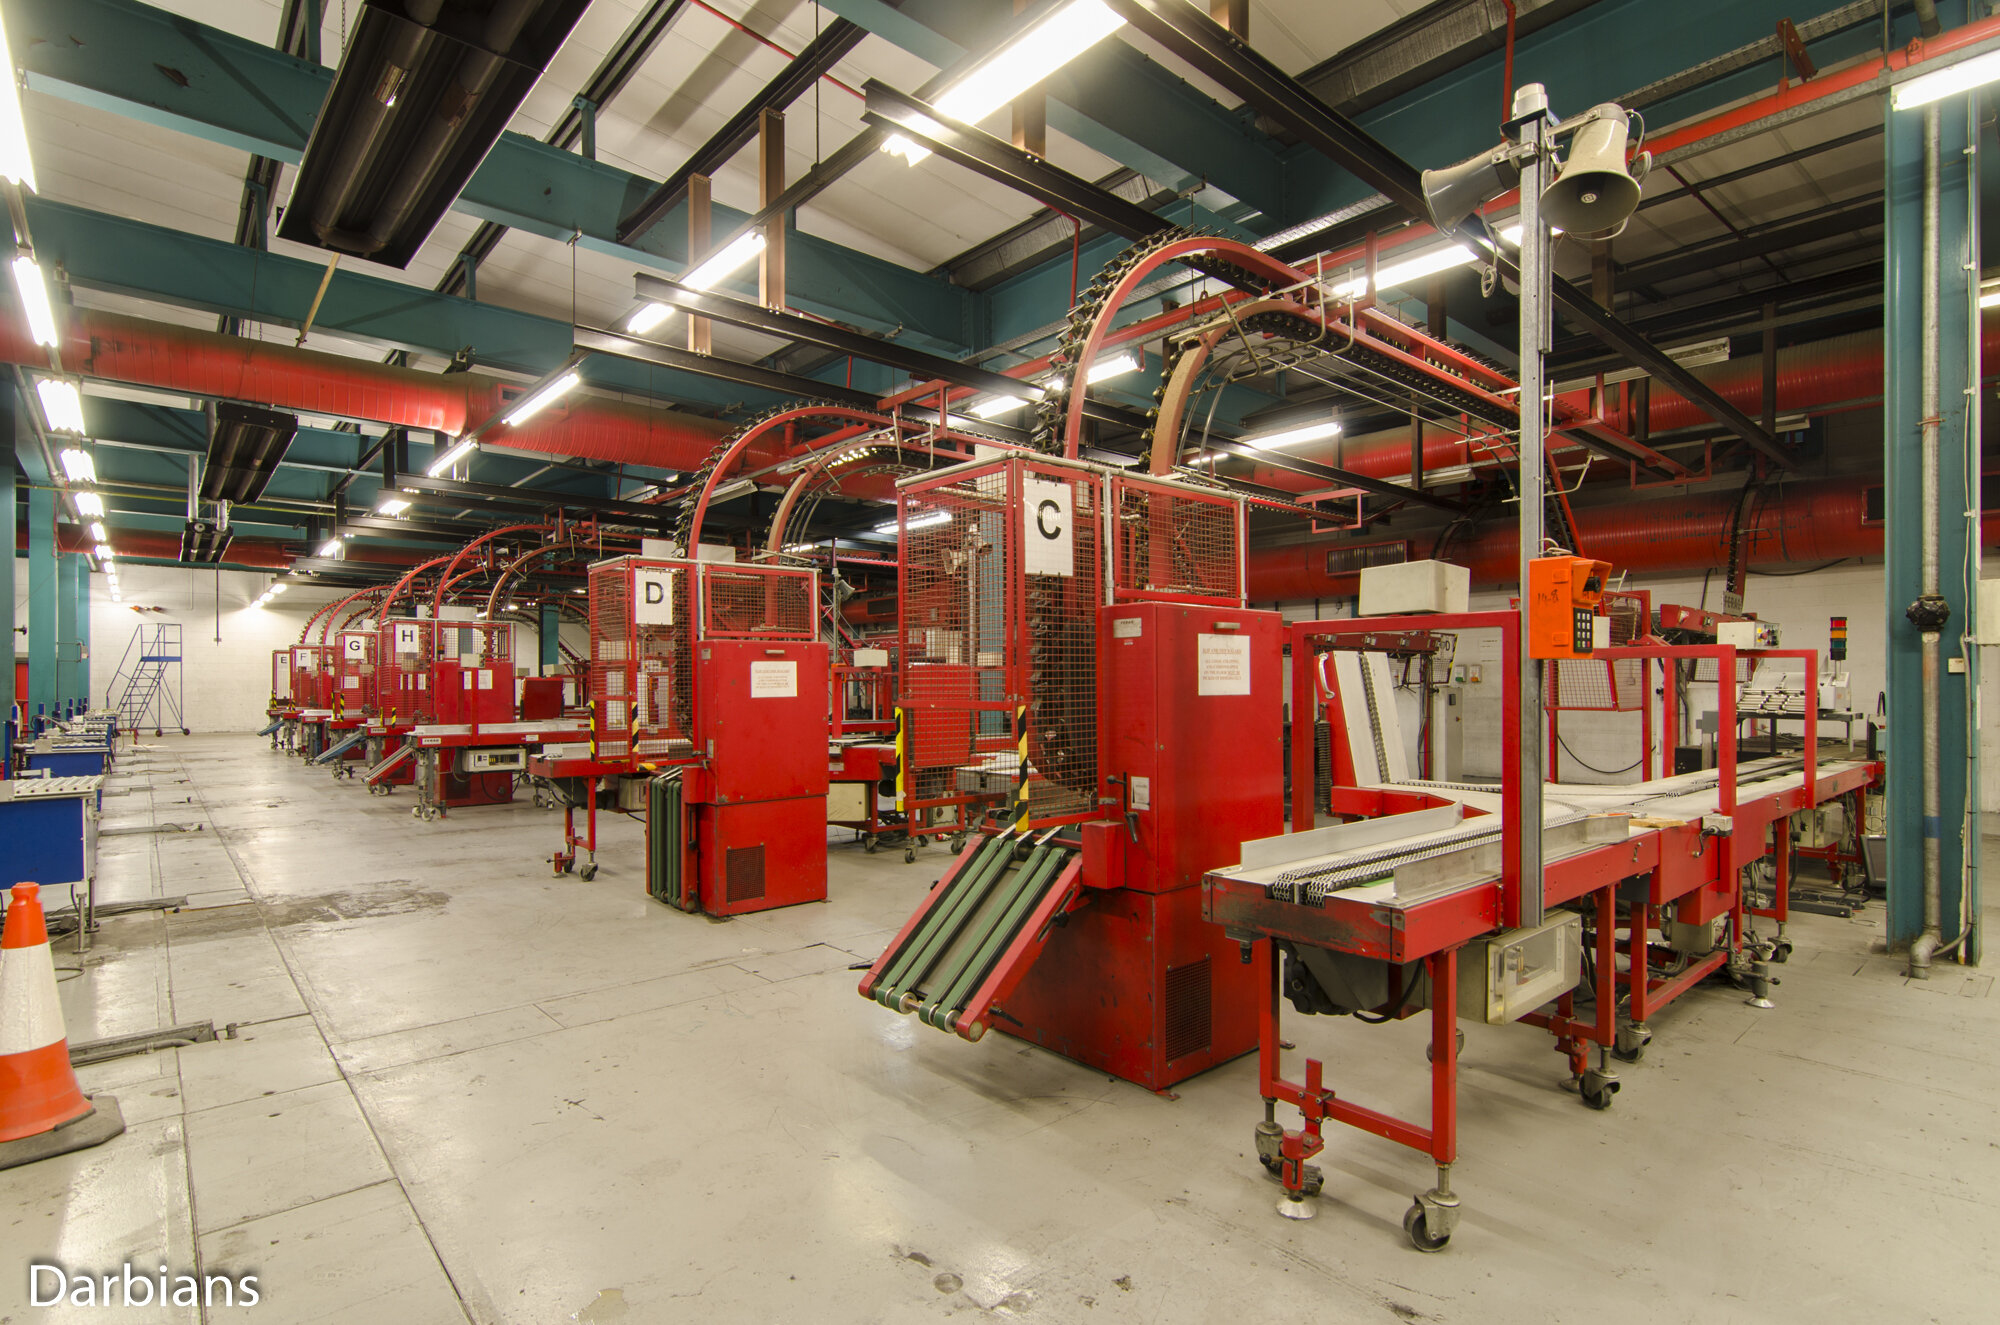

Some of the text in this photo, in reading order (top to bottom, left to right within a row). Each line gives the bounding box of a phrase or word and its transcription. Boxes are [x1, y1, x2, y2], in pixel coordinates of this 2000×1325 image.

[1037, 499, 1062, 540] C
[645, 581, 664, 604] D
[402, 630, 413, 642] H
[349, 640, 360, 651] G
[280, 656, 287, 664] E
[300, 652, 307, 661] F
